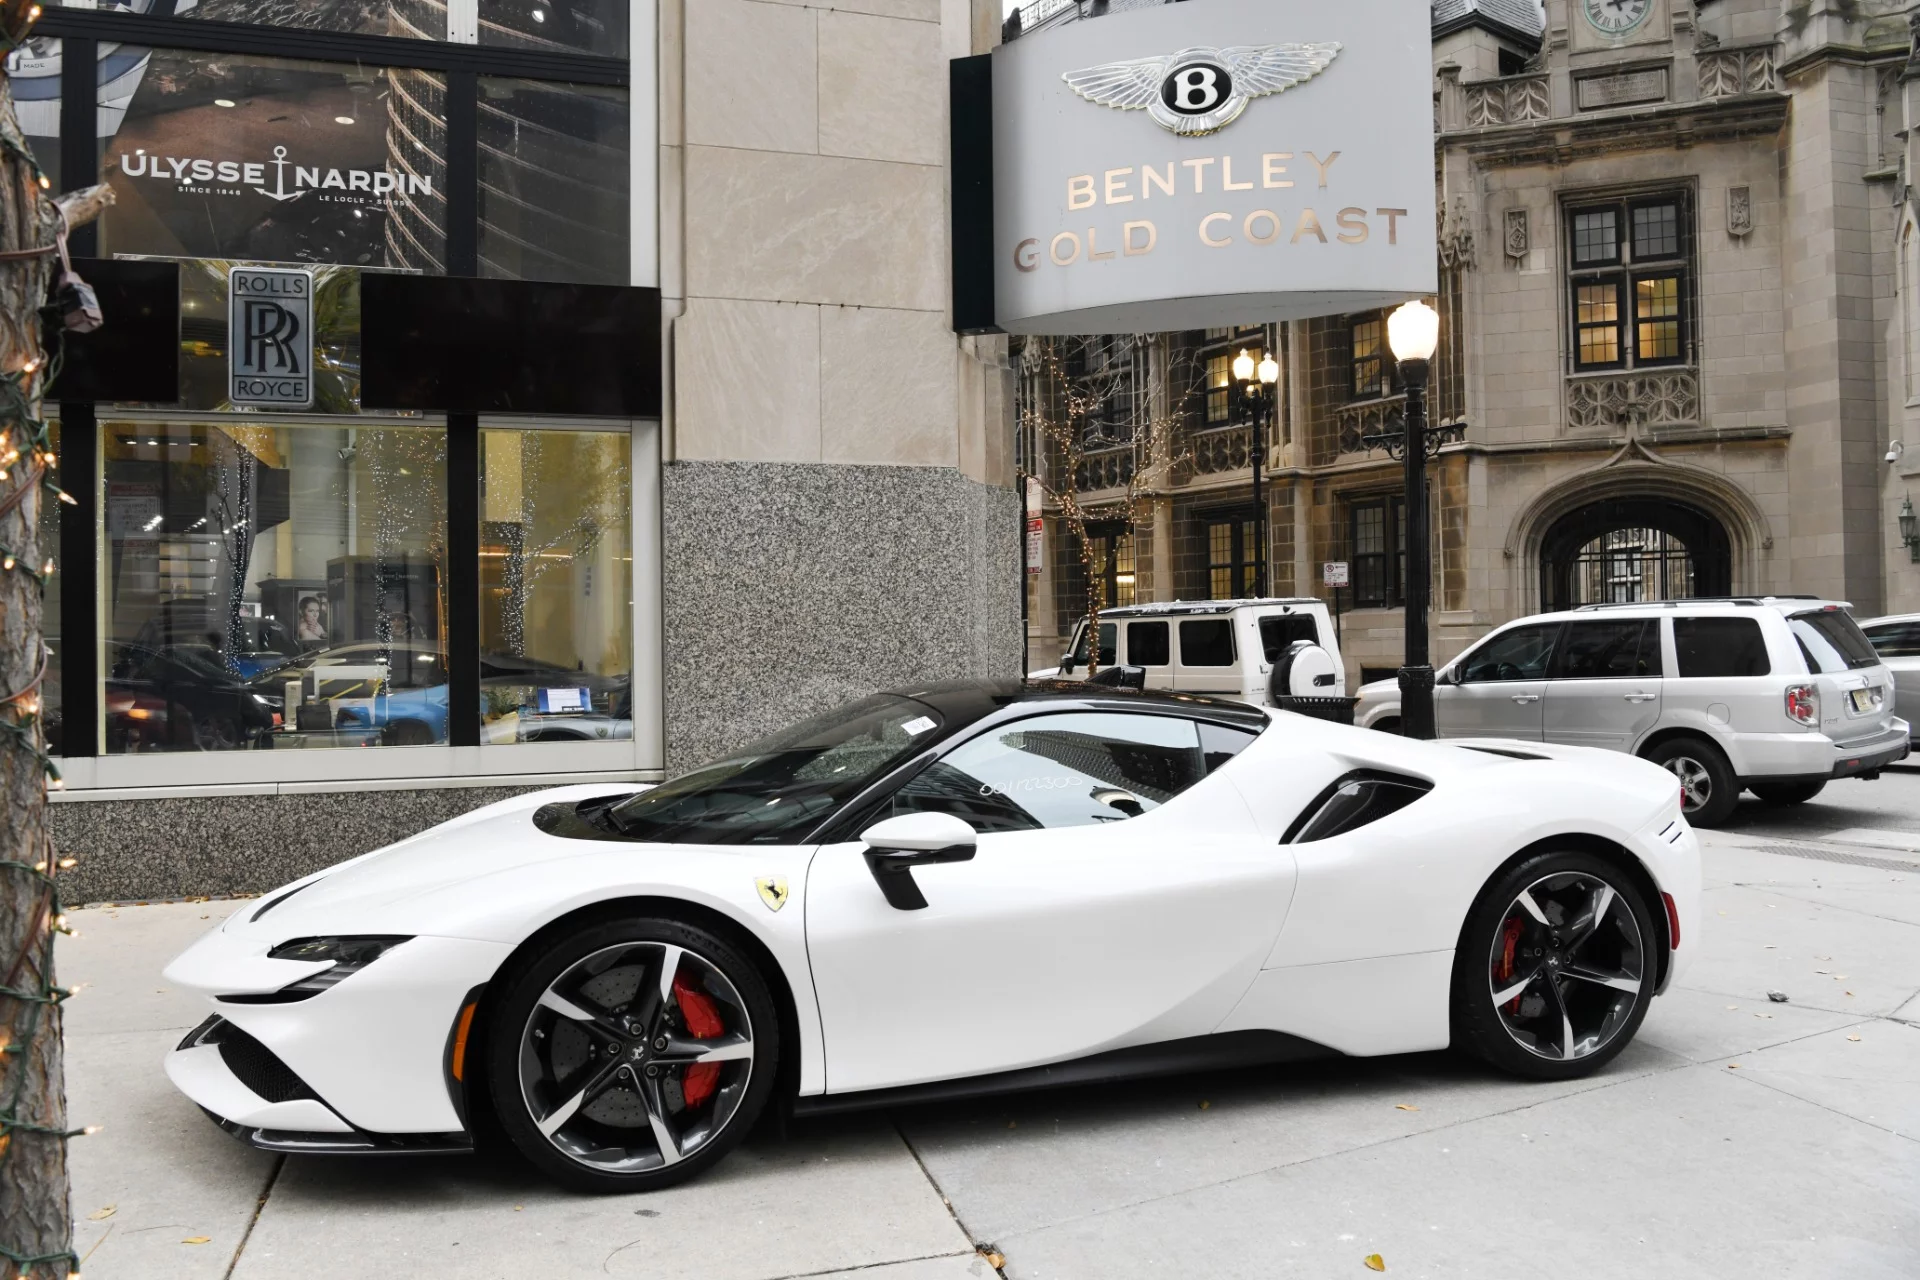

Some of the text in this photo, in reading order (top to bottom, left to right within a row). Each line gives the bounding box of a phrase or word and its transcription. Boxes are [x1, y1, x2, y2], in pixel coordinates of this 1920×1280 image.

[121, 154, 432, 196] ULYSSE NARDIN
[1067, 150, 1342, 212] BENTLEY
[177, 186, 211, 194] SINCE
[319, 194, 330, 202] LE
[334, 195, 365, 204] LOCLE
[1013, 207, 1408, 273] GOLD COAST
[238, 275, 304, 294] ROLLS
[238, 380, 304, 398] ROYCE
